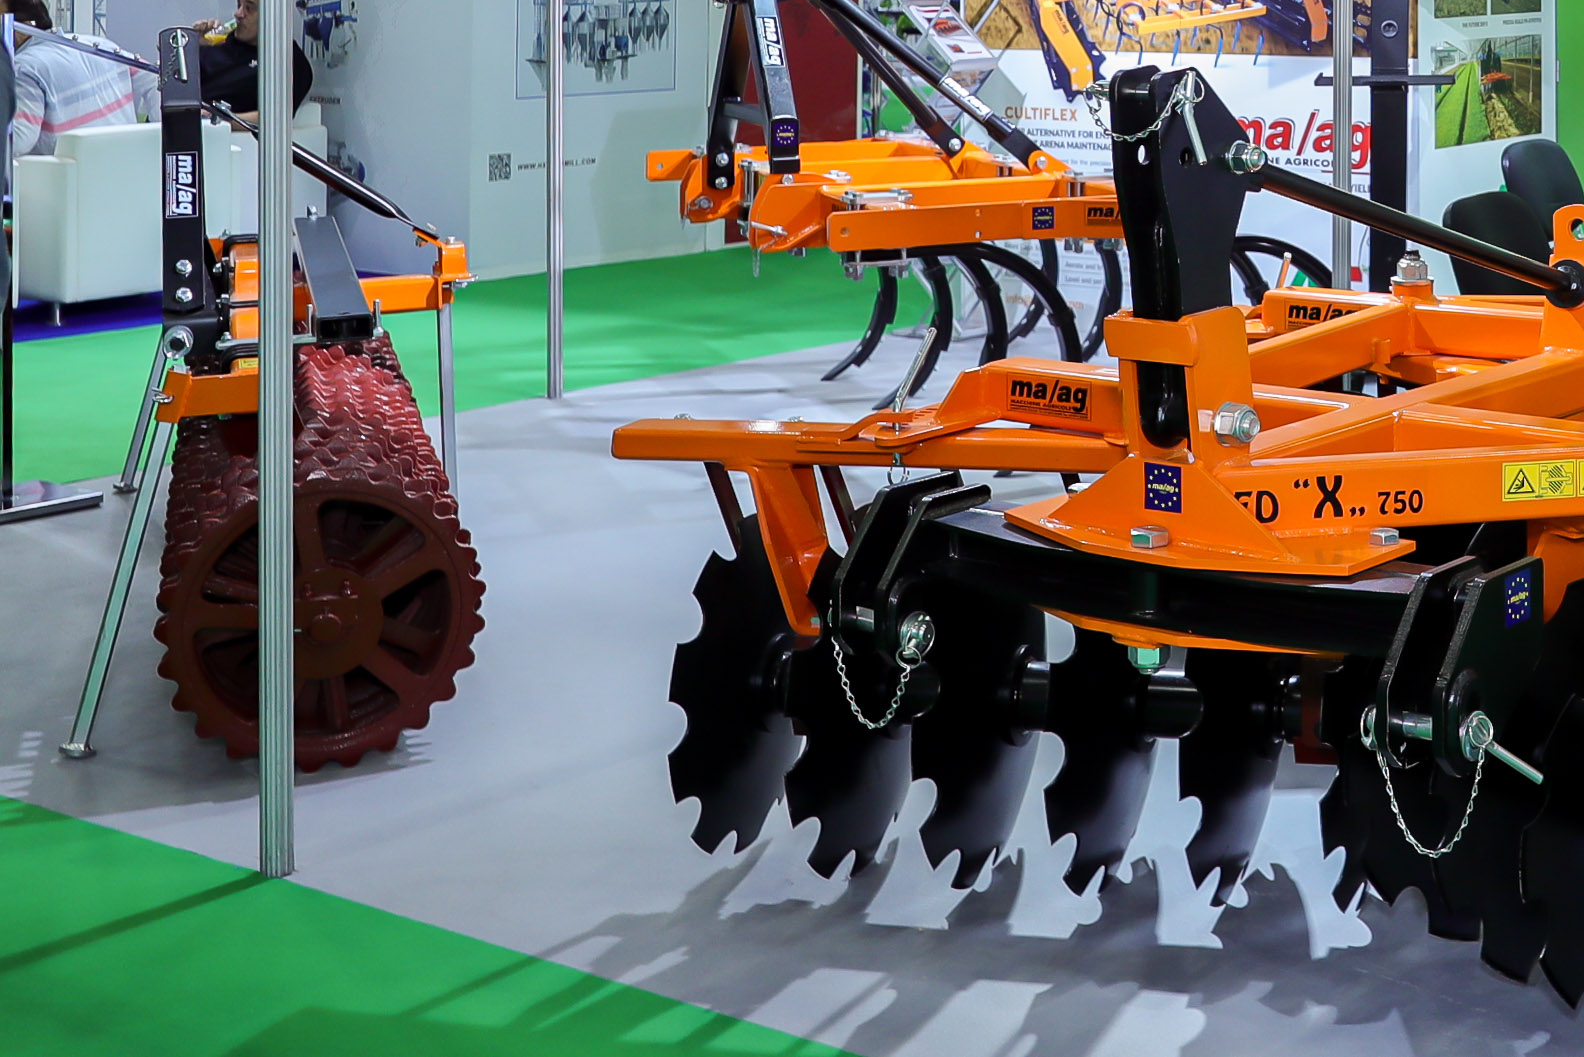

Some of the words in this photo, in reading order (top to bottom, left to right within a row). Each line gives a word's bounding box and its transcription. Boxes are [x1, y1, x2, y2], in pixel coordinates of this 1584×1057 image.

[1005, 106, 1078, 122] CULTIFLEX
[1027, 128, 1076, 138] ALTERNATIVE
[1078, 130, 1093, 138] FOR
[1040, 140, 1066, 149] ARENA
[1067, 141, 1112, 151] MAINTENAC
[1285, 158, 1333, 167] AGRICO
[172, 154, 197, 215] ma/ag
[1087, 207, 1121, 220] ma/
[1011, 379, 1088, 412] ma/ag
[1152, 482, 1175, 493] ma/ag
[1377, 489, 1424, 515] 750
